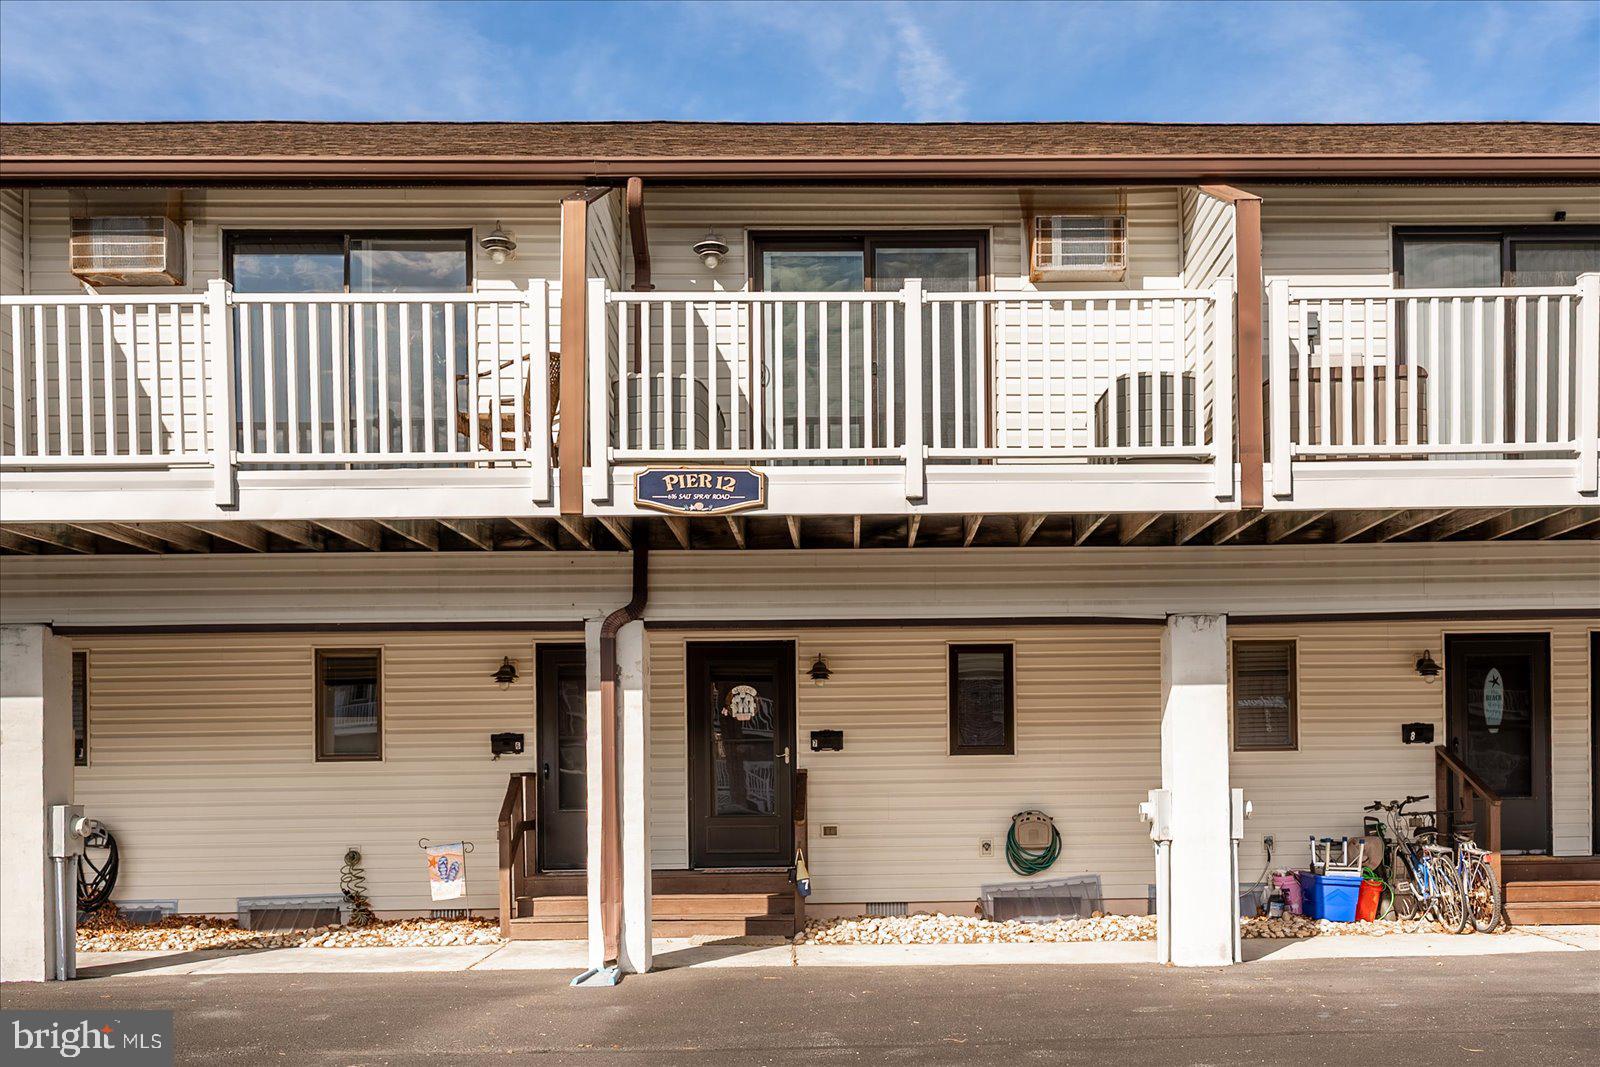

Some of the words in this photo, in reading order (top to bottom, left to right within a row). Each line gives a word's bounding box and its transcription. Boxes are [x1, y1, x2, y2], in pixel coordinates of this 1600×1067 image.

[662, 473, 712, 491] PIER
[716, 476, 736, 492] 12
[1410, 731, 1416, 741] 8
[801, 879, 809, 890] 7
